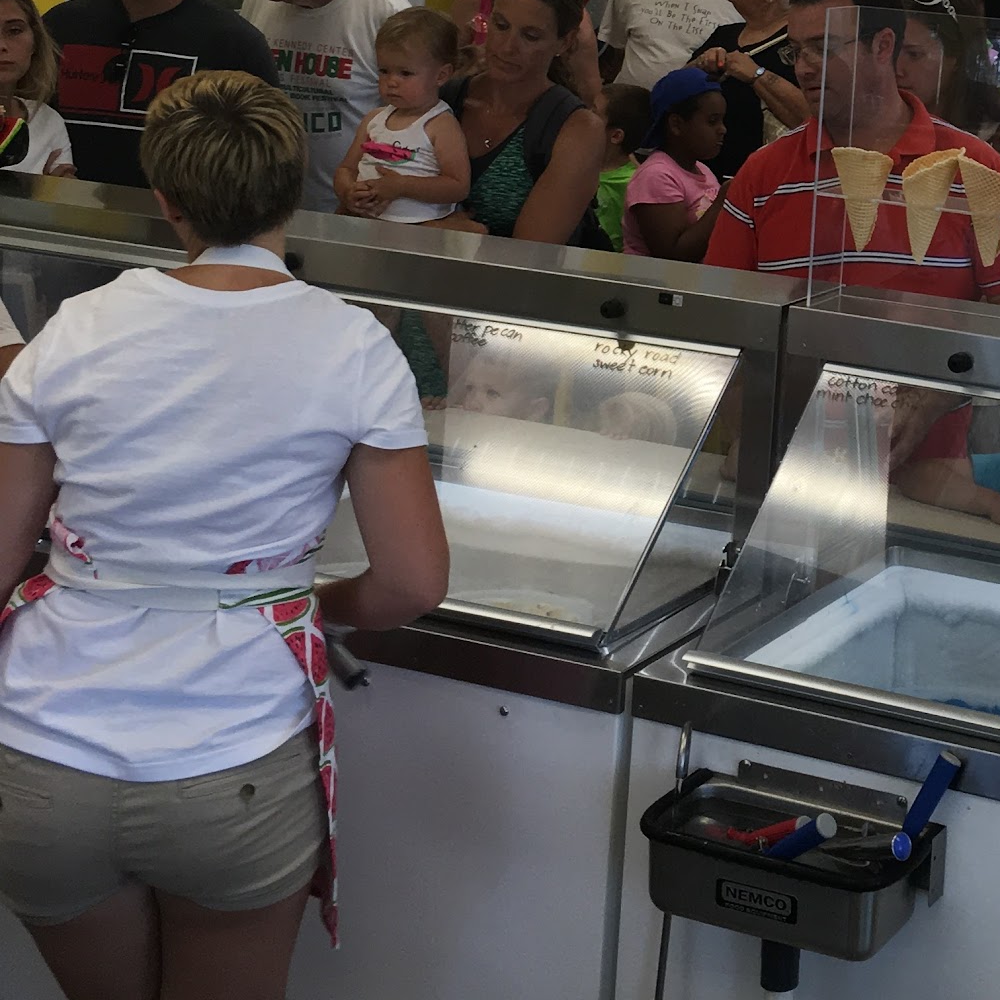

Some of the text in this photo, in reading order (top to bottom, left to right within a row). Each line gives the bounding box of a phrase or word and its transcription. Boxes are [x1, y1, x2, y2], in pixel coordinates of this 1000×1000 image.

[666, 10, 676, 19] Be
[681, 13, 696, 23] The
[684, 2, 690, 11] I
[668, 20, 683, 31] The
[686, 23, 704, 35] List
[273, 38, 354, 57] KENNEDY CENTER
[271, 48, 353, 80] EN HOUSE
[303, 111, 342, 133] ICO
[454, 319, 523, 342] tter pecan
[593, 341, 681, 365] rocky road
[592, 358, 672, 379] sweet corn
[827, 376, 877, 391] cotton
[816, 389, 852, 402] mint
[725, 886, 787, 911] NEMCO
